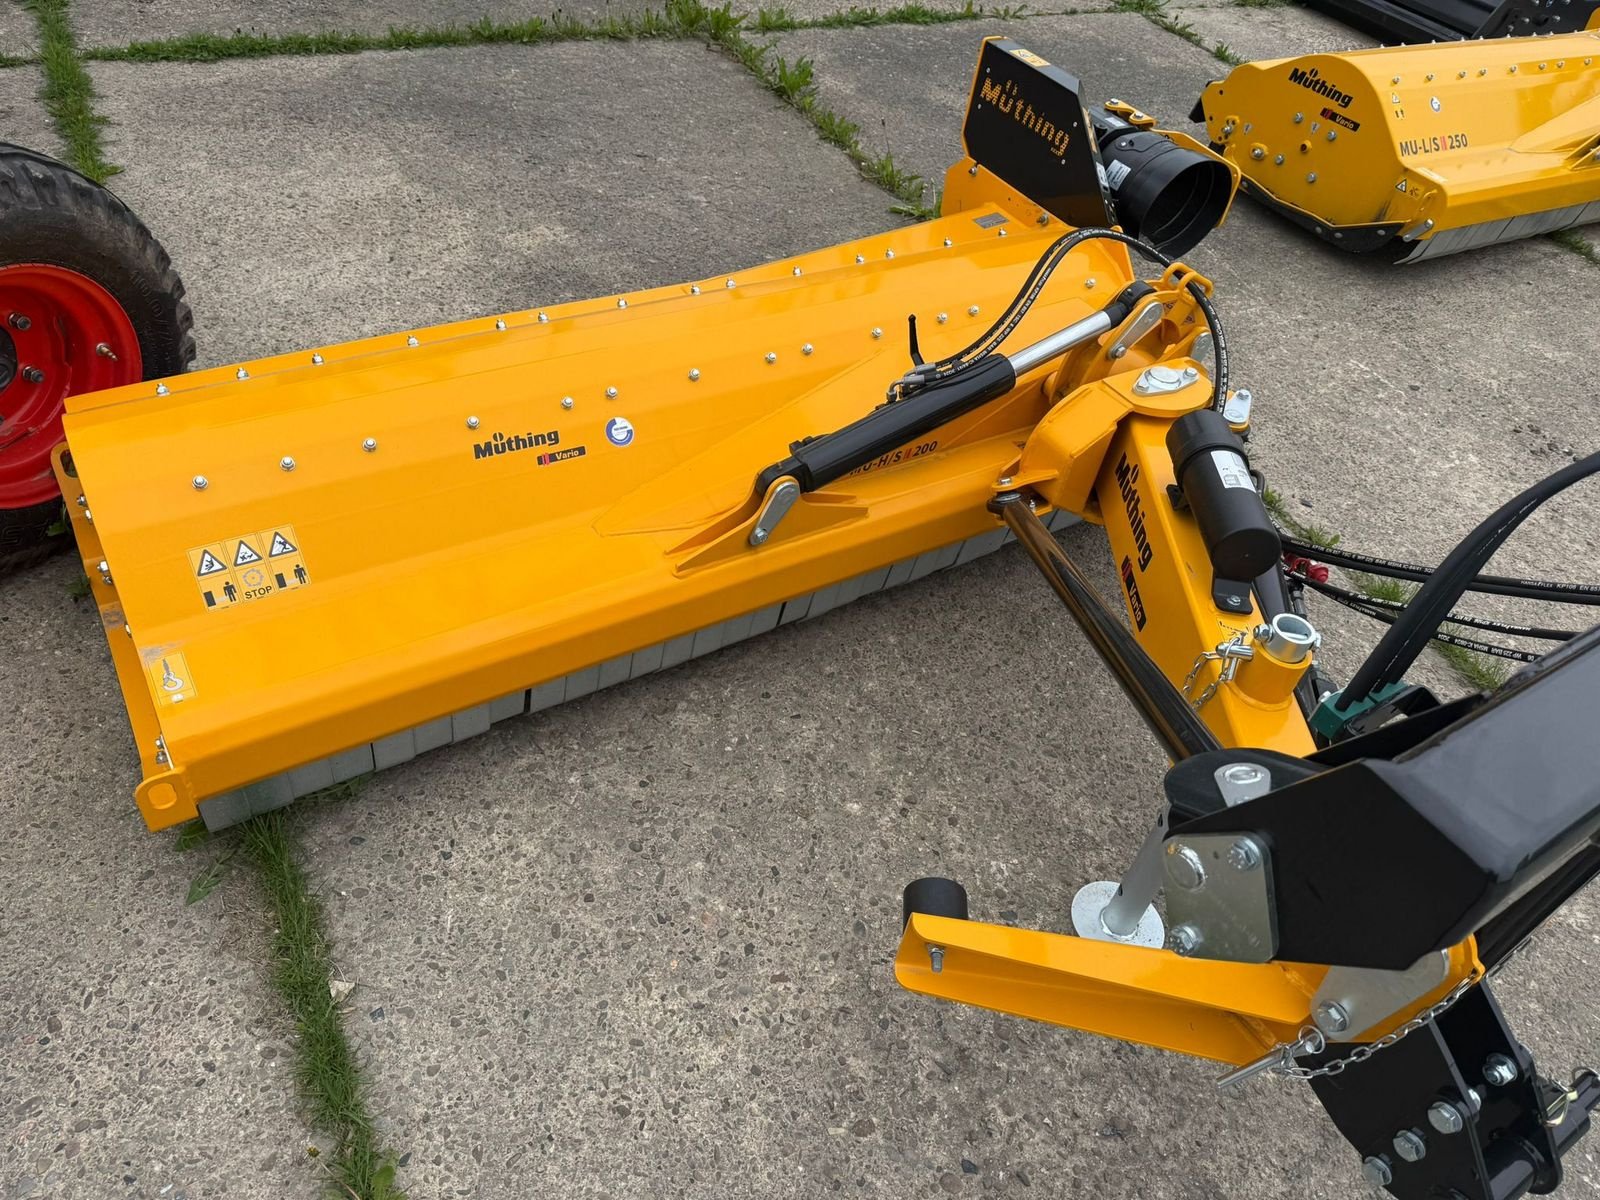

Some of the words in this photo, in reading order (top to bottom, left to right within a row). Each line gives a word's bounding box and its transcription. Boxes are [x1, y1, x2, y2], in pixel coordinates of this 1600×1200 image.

[1288, 67, 1354, 109] Müthing
[980, 77, 1070, 156] Müthing
[1335, 115, 1355, 130] Vario
[1449, 133, 1468, 150] 250
[473, 430, 560, 459] Müthing
[912, 440, 938, 457] 200
[555, 449, 580, 461] Vario
[1114, 451, 1153, 573] Müthing
[244, 585, 272, 600] STOP
[1128, 582, 1143, 623] Vario
[1473, 643, 1489, 652] MSHA
[1490, 647, 1503, 656] BAR
